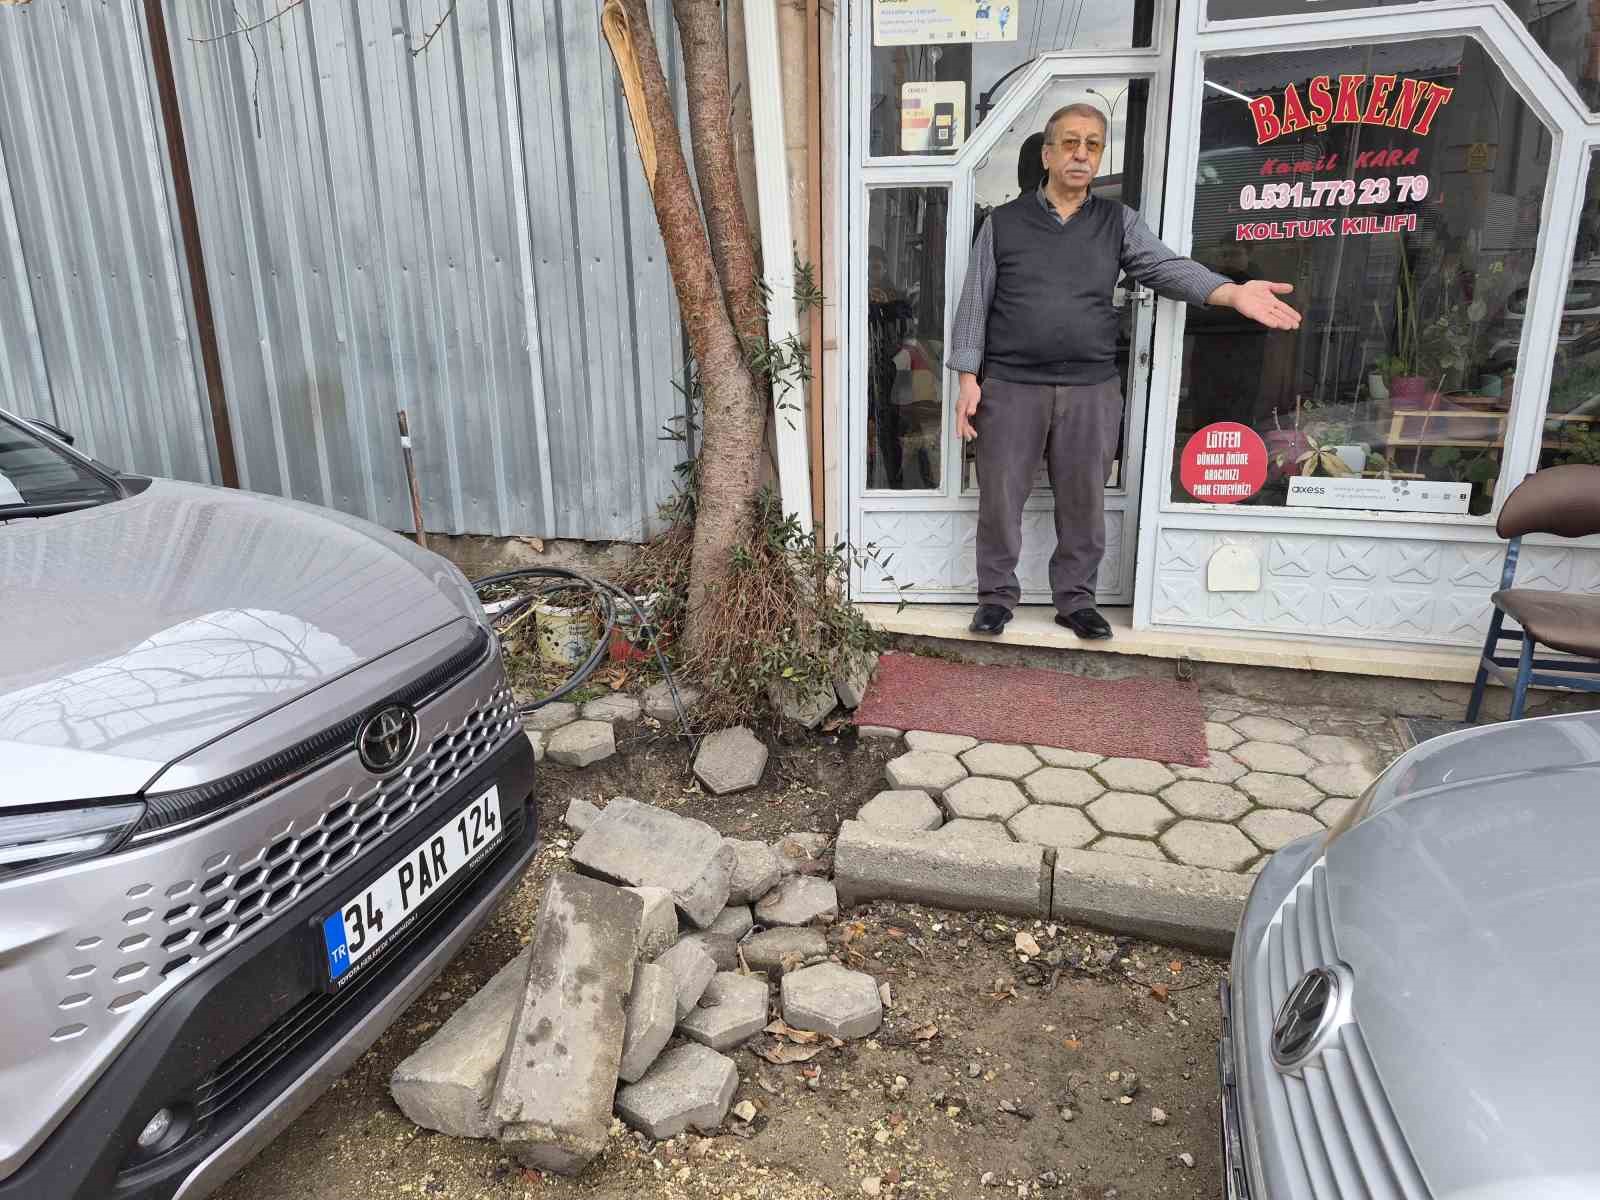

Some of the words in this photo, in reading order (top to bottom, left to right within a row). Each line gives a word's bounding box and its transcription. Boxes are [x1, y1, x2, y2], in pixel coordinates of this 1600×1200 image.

[1248, 74, 1453, 145] BAŞKENT
[1354, 147, 1420, 169] KARA
[1239, 179, 1357, 210] 0.531.773
[1357, 177, 1391, 205] 23
[1396, 175, 1430, 203] 79
[1235, 218, 1335, 241] KOLTUK
[1340, 213, 1418, 235] KILIFI
[1206, 430, 1241, 448] LÜTFEN
[1193, 484, 1212, 496] PARK
[1291, 486, 1326, 495] axess
[345, 892, 384, 954] 34
[398, 835, 448, 911] PAR
[457, 797, 496, 856] 124
[331, 943, 347, 964] TR
[337, 964, 360, 988] TOYOTA
